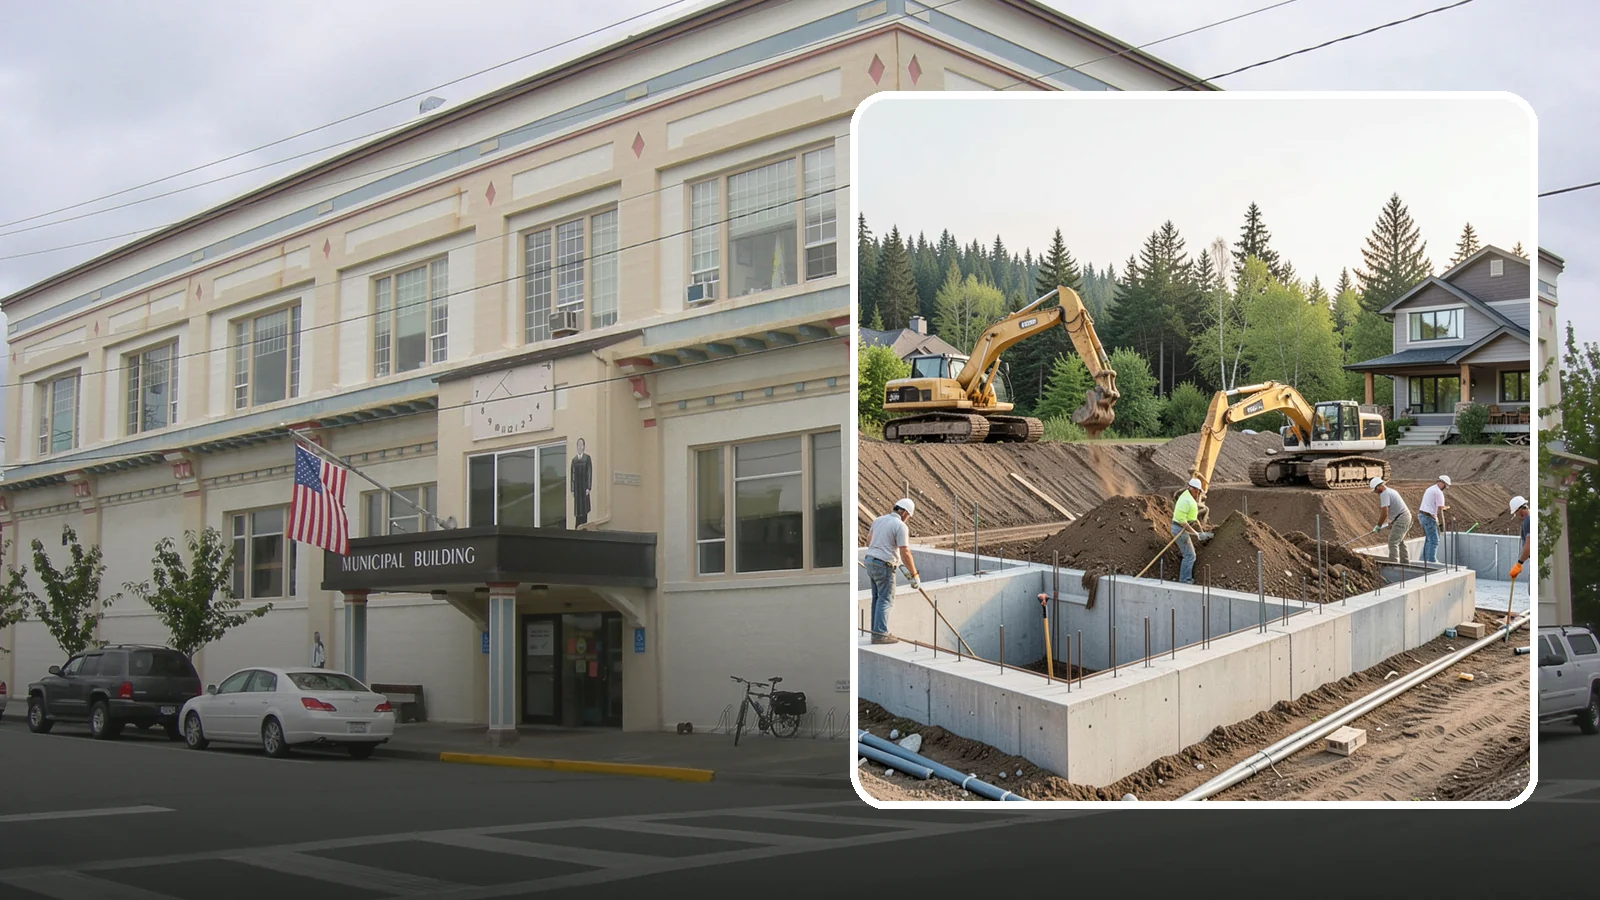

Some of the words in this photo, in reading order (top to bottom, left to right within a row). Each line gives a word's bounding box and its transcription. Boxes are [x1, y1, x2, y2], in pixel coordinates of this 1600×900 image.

[536, 402, 540, 410] 4
[480, 407, 485, 415] 8
[487, 417, 492, 426] 9
[529, 413, 533, 422] 3
[494, 423, 500, 432] 10
[521, 420, 525, 428] 2
[501, 425, 506, 433] 11
[507, 425, 513, 433] 12
[342, 552, 405, 572] MUNICIPAL
[414, 547, 476, 567] BUILDING
